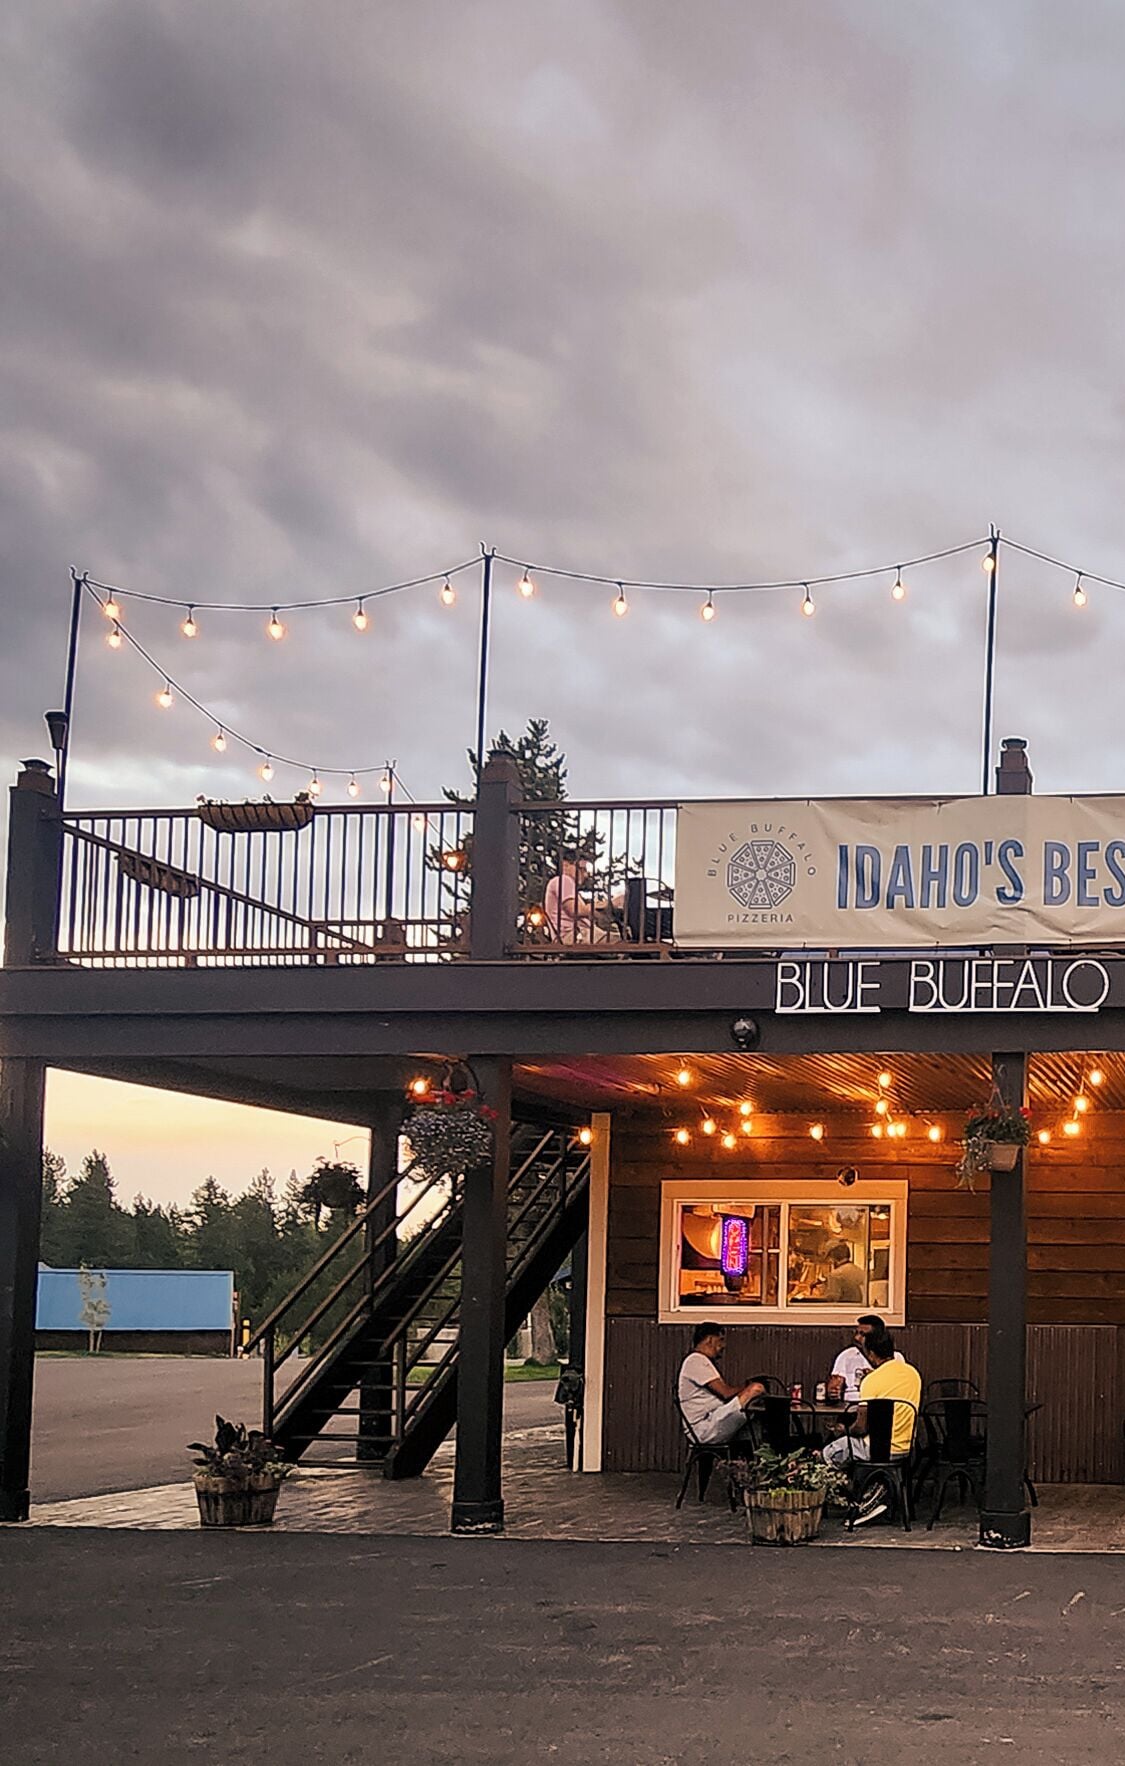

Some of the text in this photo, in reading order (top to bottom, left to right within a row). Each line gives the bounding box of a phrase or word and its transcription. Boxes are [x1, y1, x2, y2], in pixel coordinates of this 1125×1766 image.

[707, 823, 817, 877] BLUE BUFFALO
[836, 838, 1025, 910] IDAHO'S
[727, 913, 794, 923] PIZZERIA
[775, 962, 881, 1013] BLUE
[909, 959, 1109, 1012] BUFFALO
